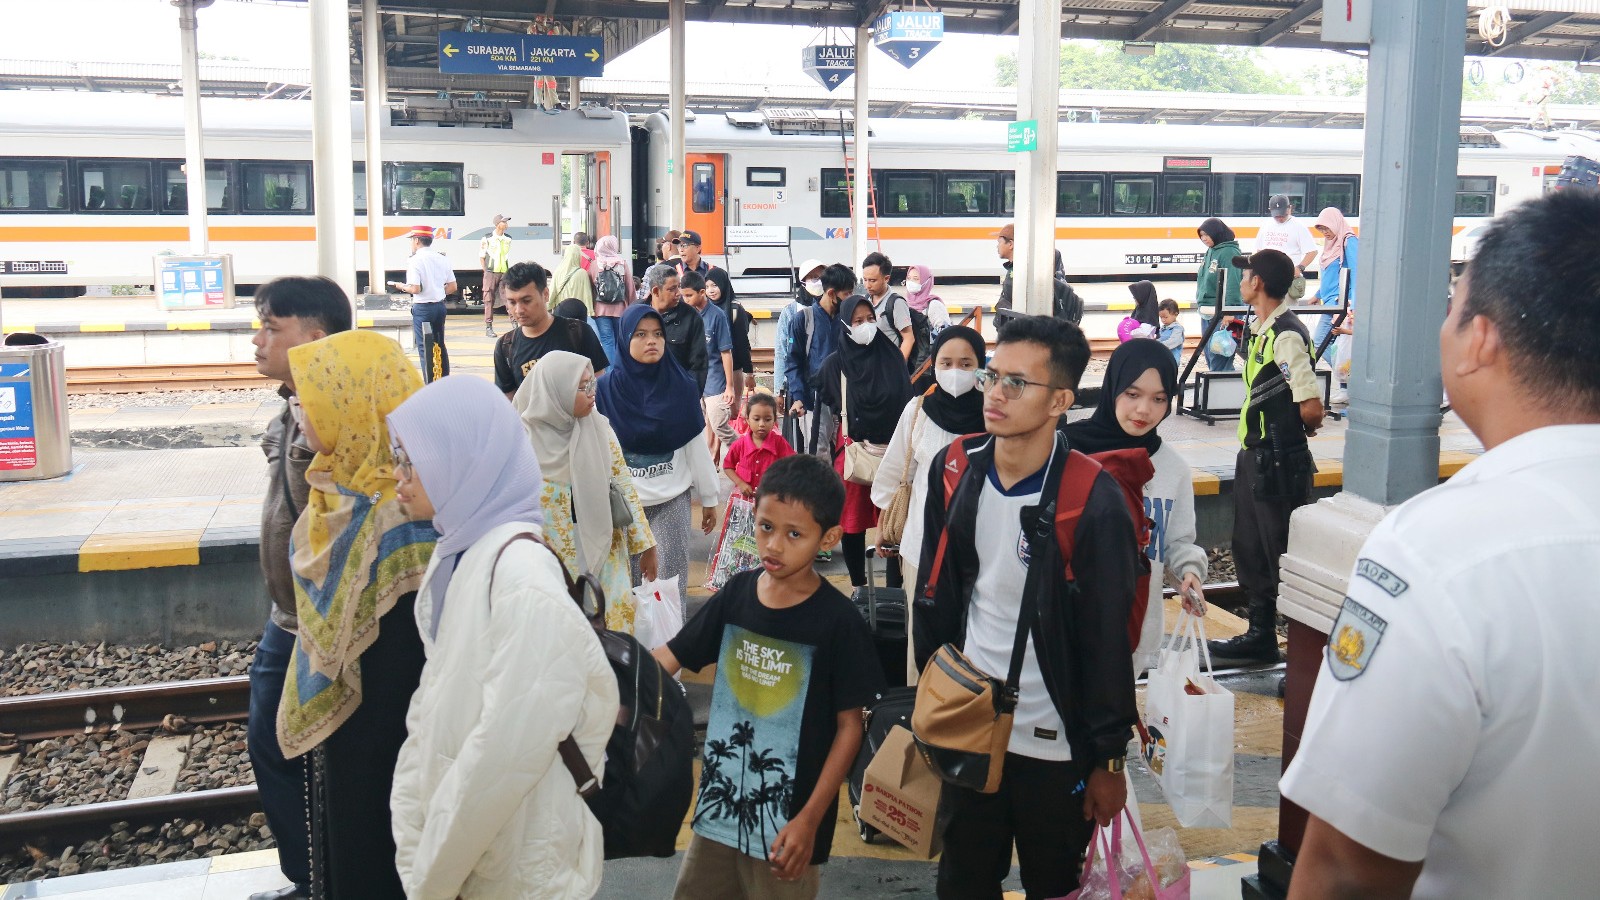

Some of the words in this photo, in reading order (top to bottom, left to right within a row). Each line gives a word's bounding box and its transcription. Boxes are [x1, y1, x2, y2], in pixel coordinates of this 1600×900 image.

[896, 16, 941, 28] JALUR
[904, 30, 932, 38] TRACK
[467, 45, 517, 56] SURABAYA
[530, 47, 577, 58] JAKARTA
[819, 47, 855, 59] JALUR
[908, 47, 921, 59] 3
[828, 73, 839, 83] 4
[776, 191, 783, 200] 3
[1125, 255, 1135, 263] K3
[1136, 255, 1141, 263] 0
[1143, 255, 1151, 263] 16
[1152, 255, 1161, 263] 59
[1390, 581, 1401, 592] 3
[742, 640, 760, 656] THE
[760, 646, 785, 661] SKY
[736, 648, 744, 660] IS
[743, 651, 760, 667] THE
[761, 658, 793, 674] LIMIT
[758, 671, 781, 682] DREAM
[759, 678, 776, 687] LIMIT
[886, 805, 907, 827] 25
